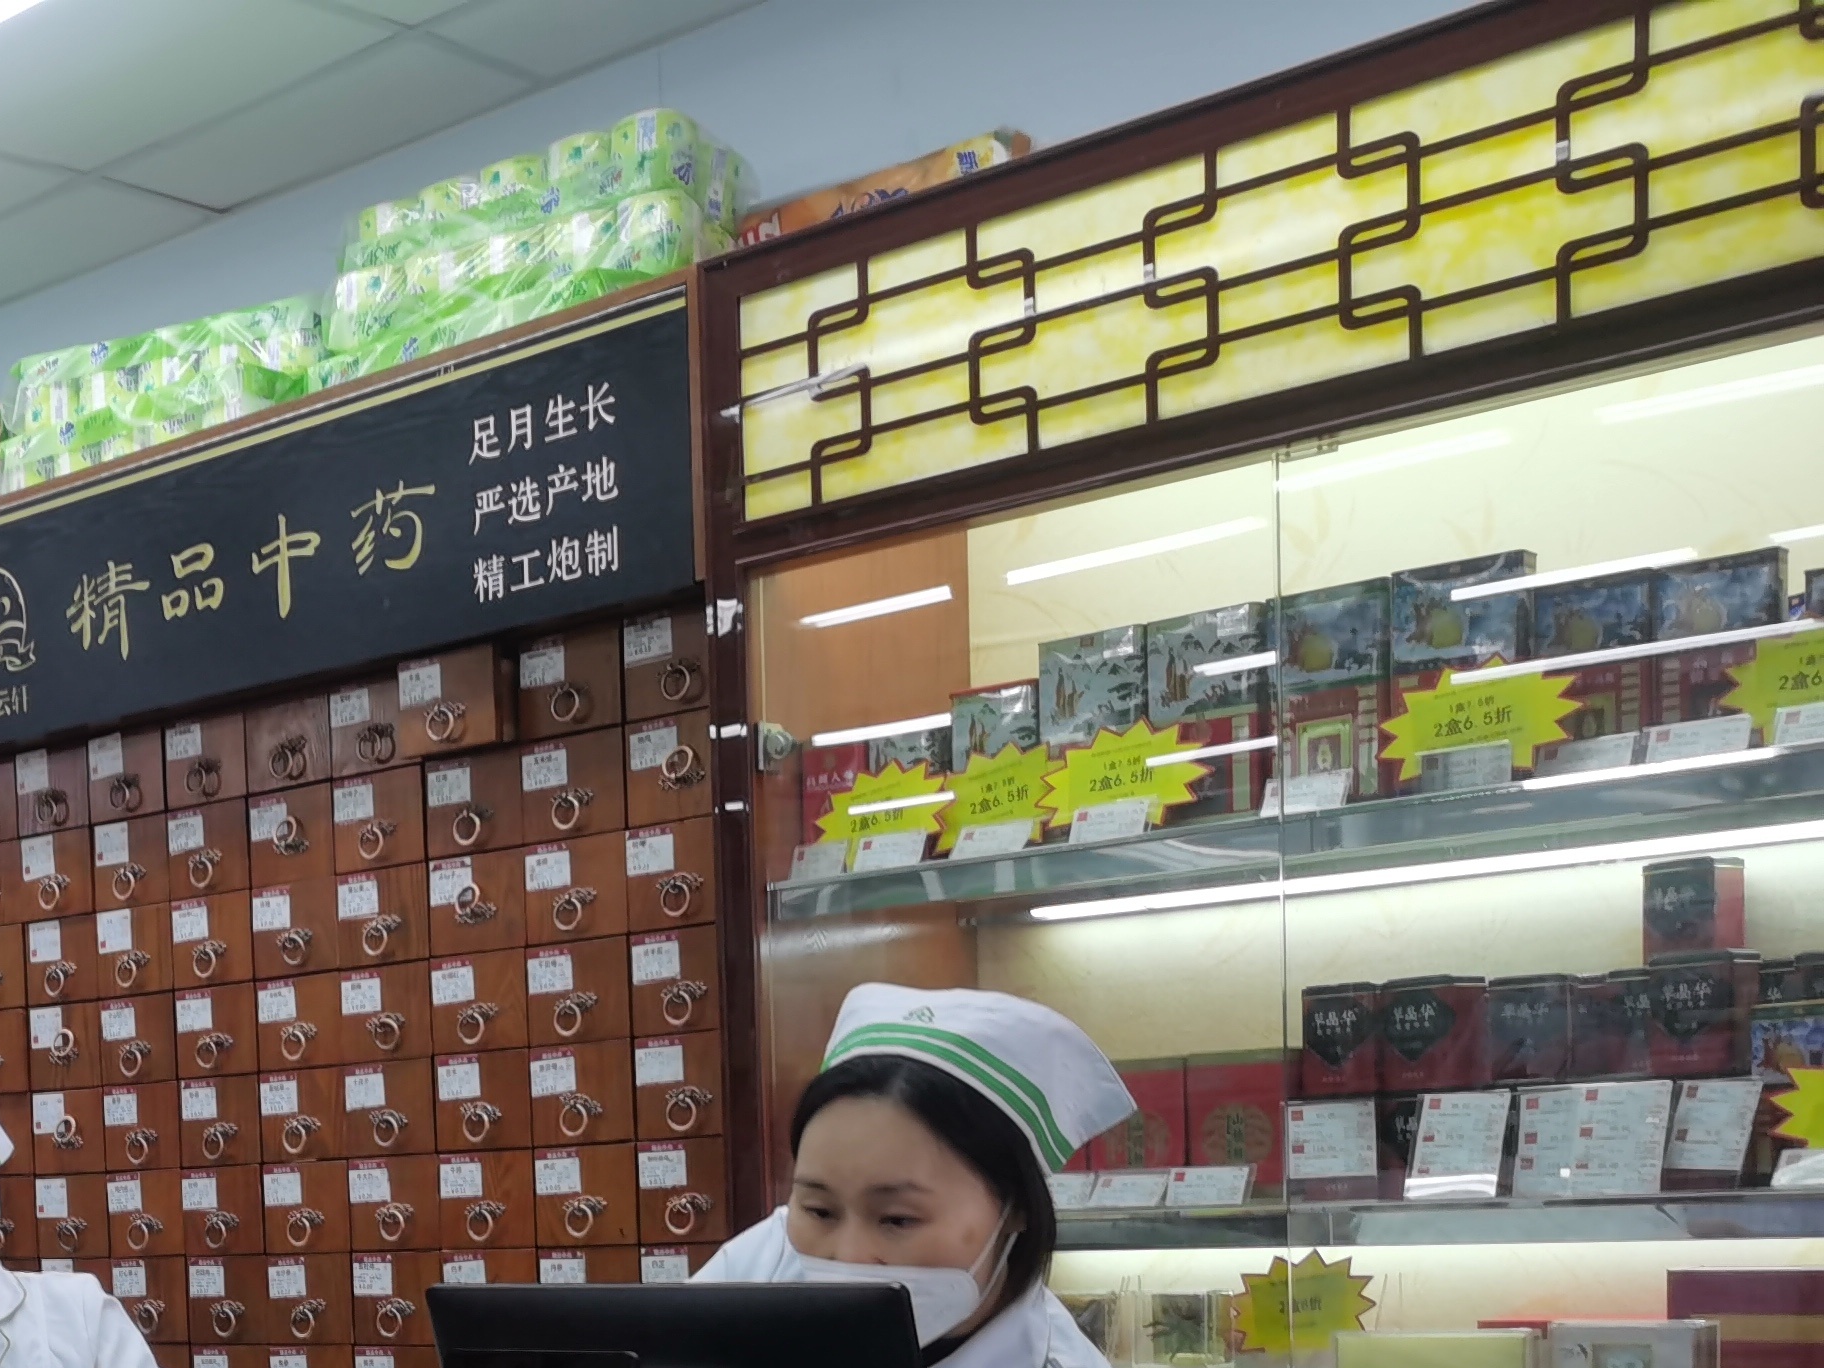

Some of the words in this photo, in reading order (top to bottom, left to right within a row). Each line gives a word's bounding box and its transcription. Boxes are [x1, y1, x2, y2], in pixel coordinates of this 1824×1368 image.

[468, 382, 616, 466] 足月生长
[474, 454, 619, 536] 严选产地
[65, 480, 436, 661] 精品中药
[473, 524, 619, 603] 精工炮制
